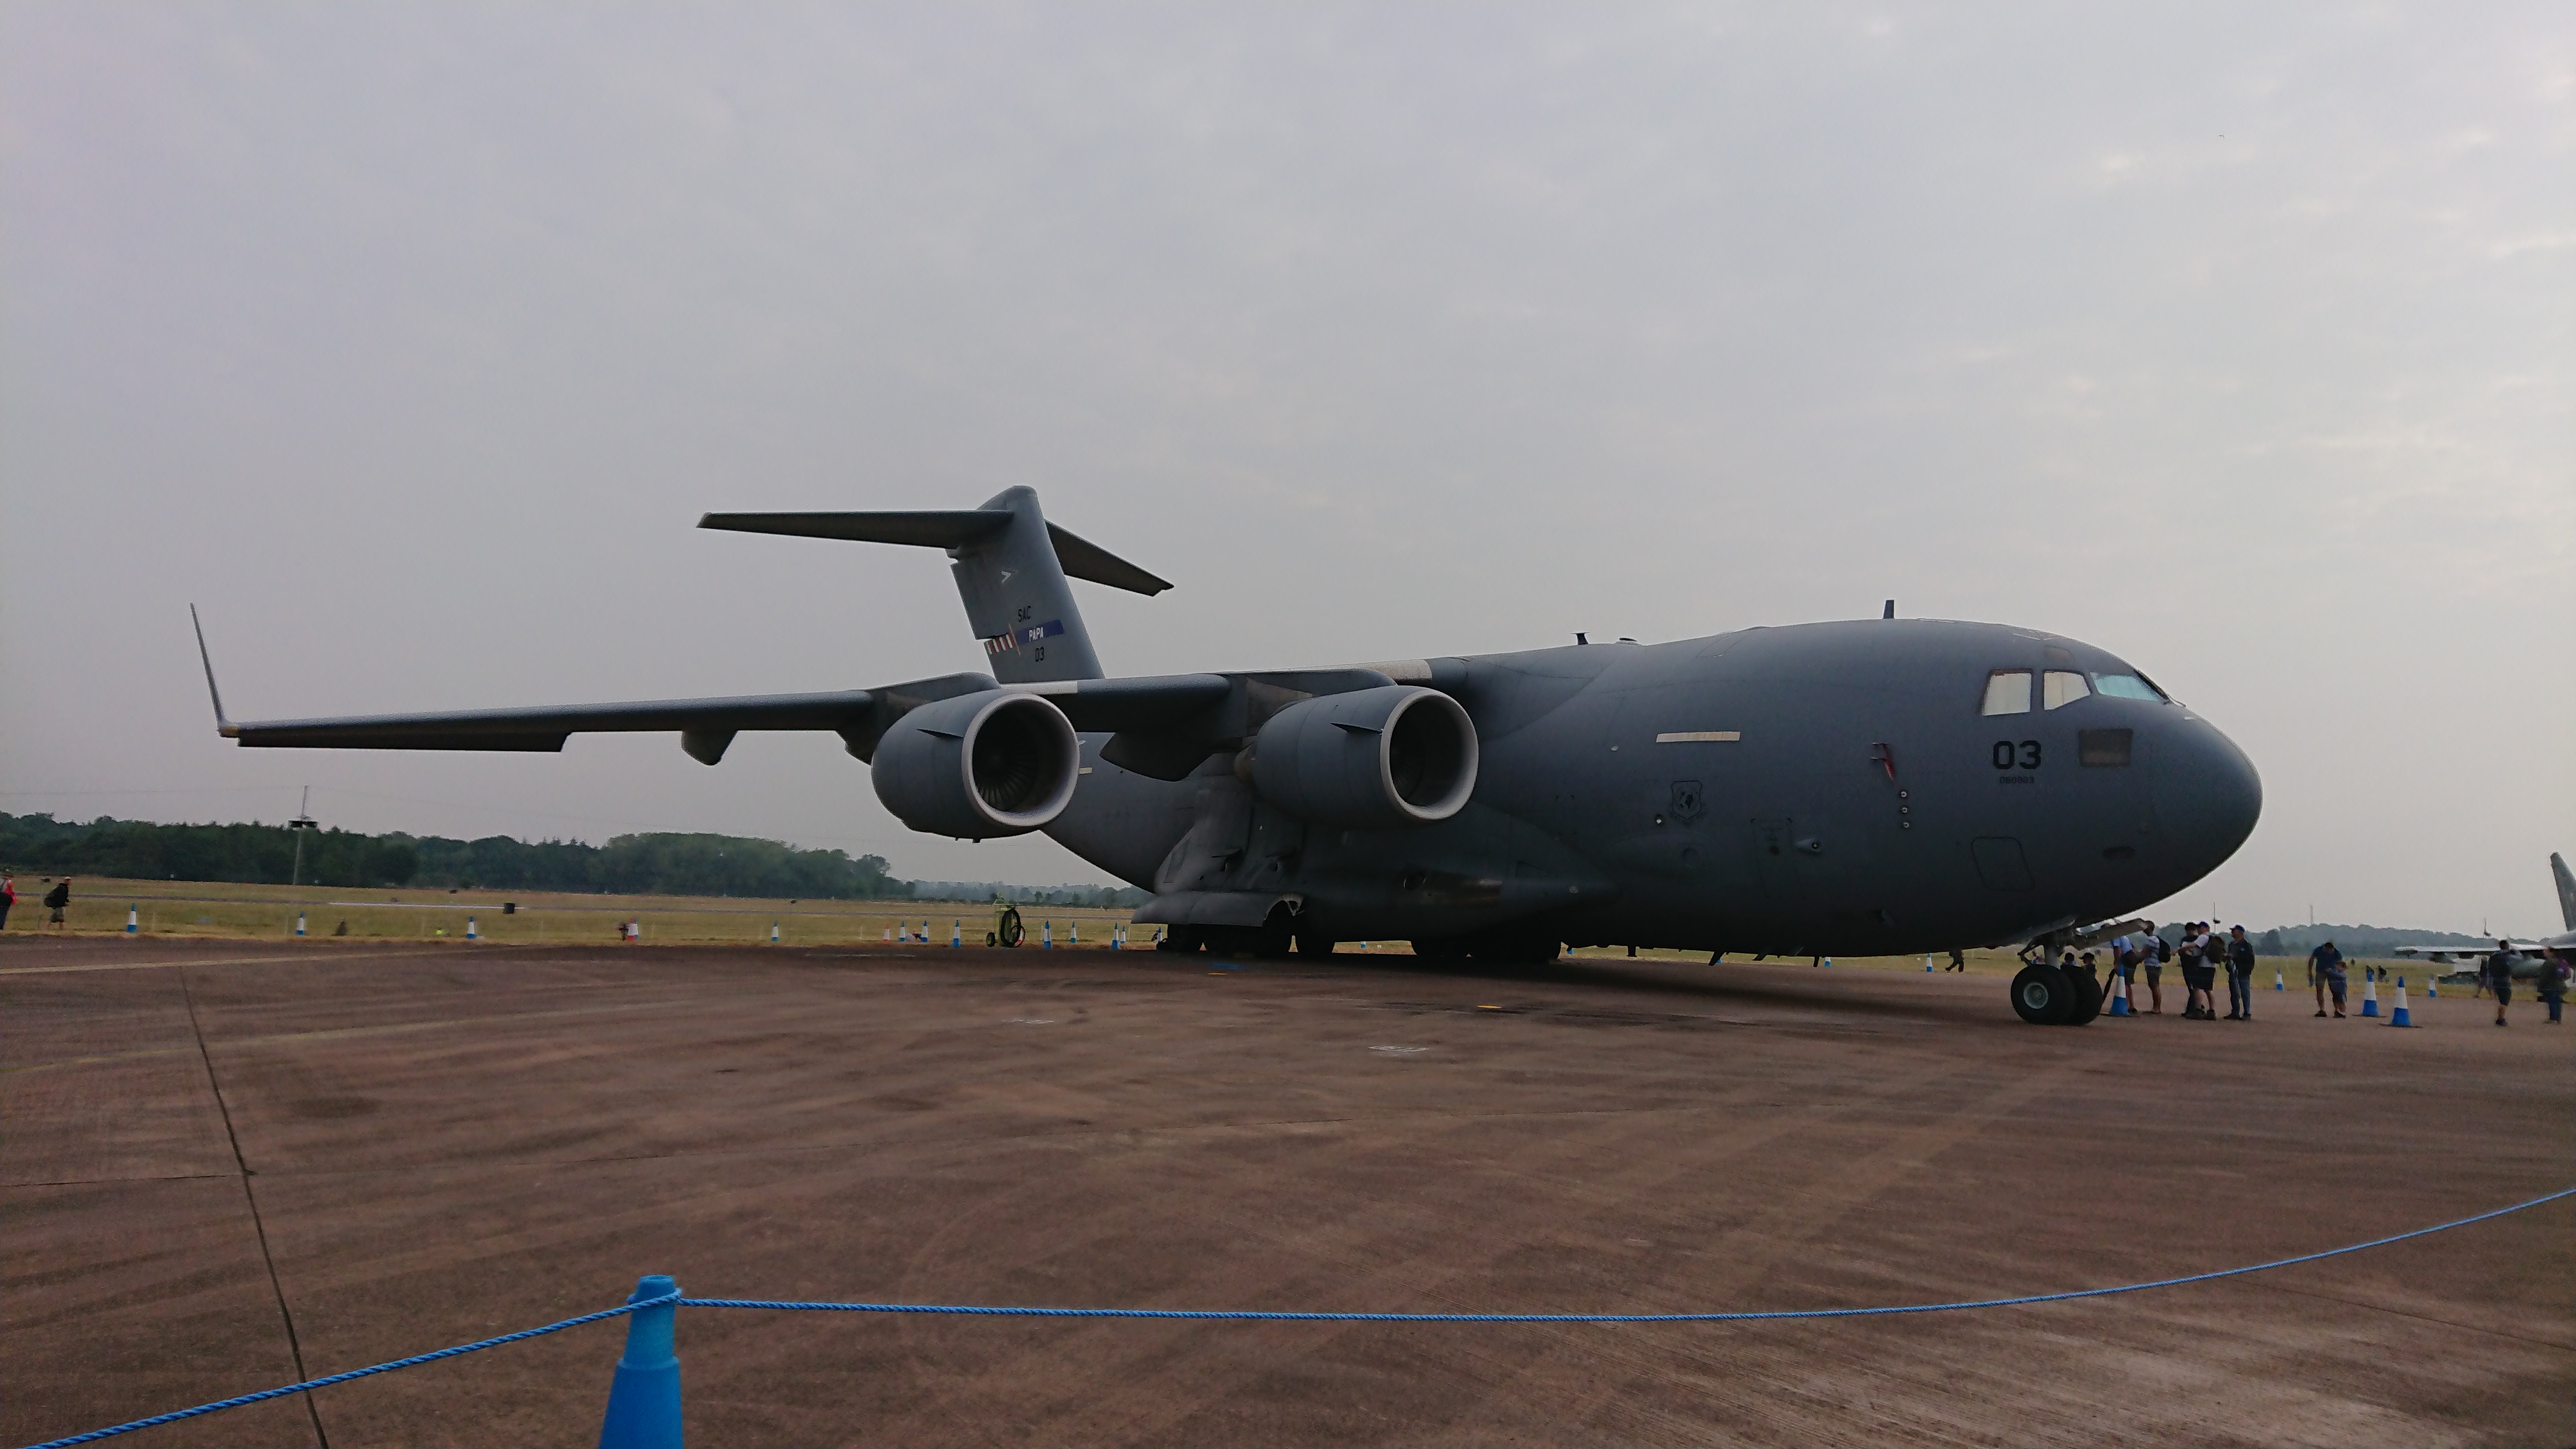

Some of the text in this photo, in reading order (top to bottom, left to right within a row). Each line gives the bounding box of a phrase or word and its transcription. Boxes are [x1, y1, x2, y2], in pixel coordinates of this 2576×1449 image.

[1018, 606, 1032, 623] SAC
[1035, 646, 1045, 662] 03
[1993, 740, 2042, 769] 03
